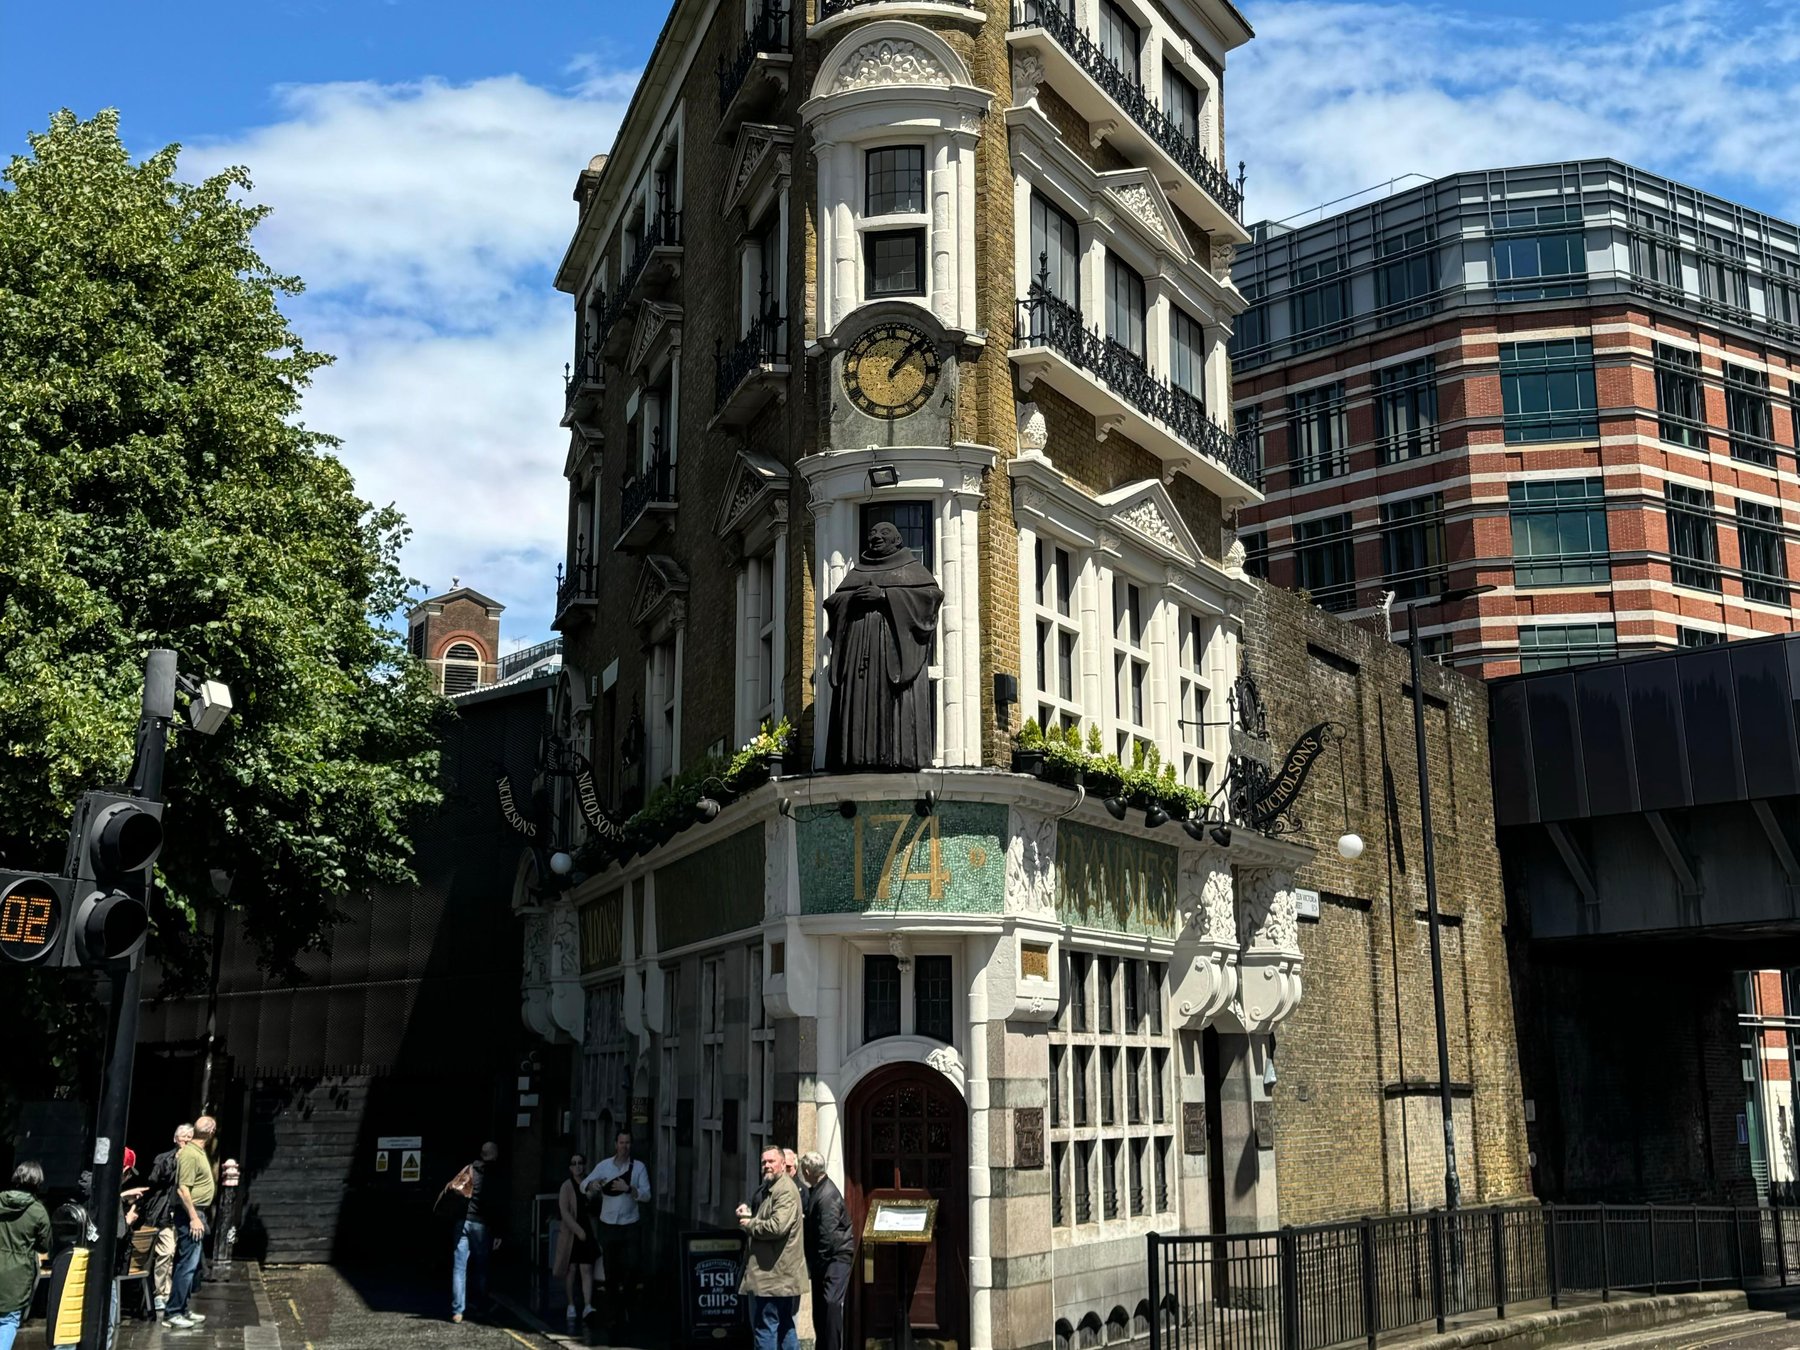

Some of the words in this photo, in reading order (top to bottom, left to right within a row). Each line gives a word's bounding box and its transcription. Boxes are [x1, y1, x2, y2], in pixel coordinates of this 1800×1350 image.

[1255, 737, 1318, 817] NICHOLSON'S
[853, 813, 951, 900] 174
[0, 895, 51, 944] 02
[698, 1294, 738, 1307] CHIPS
[700, 1272, 735, 1287] FISH
